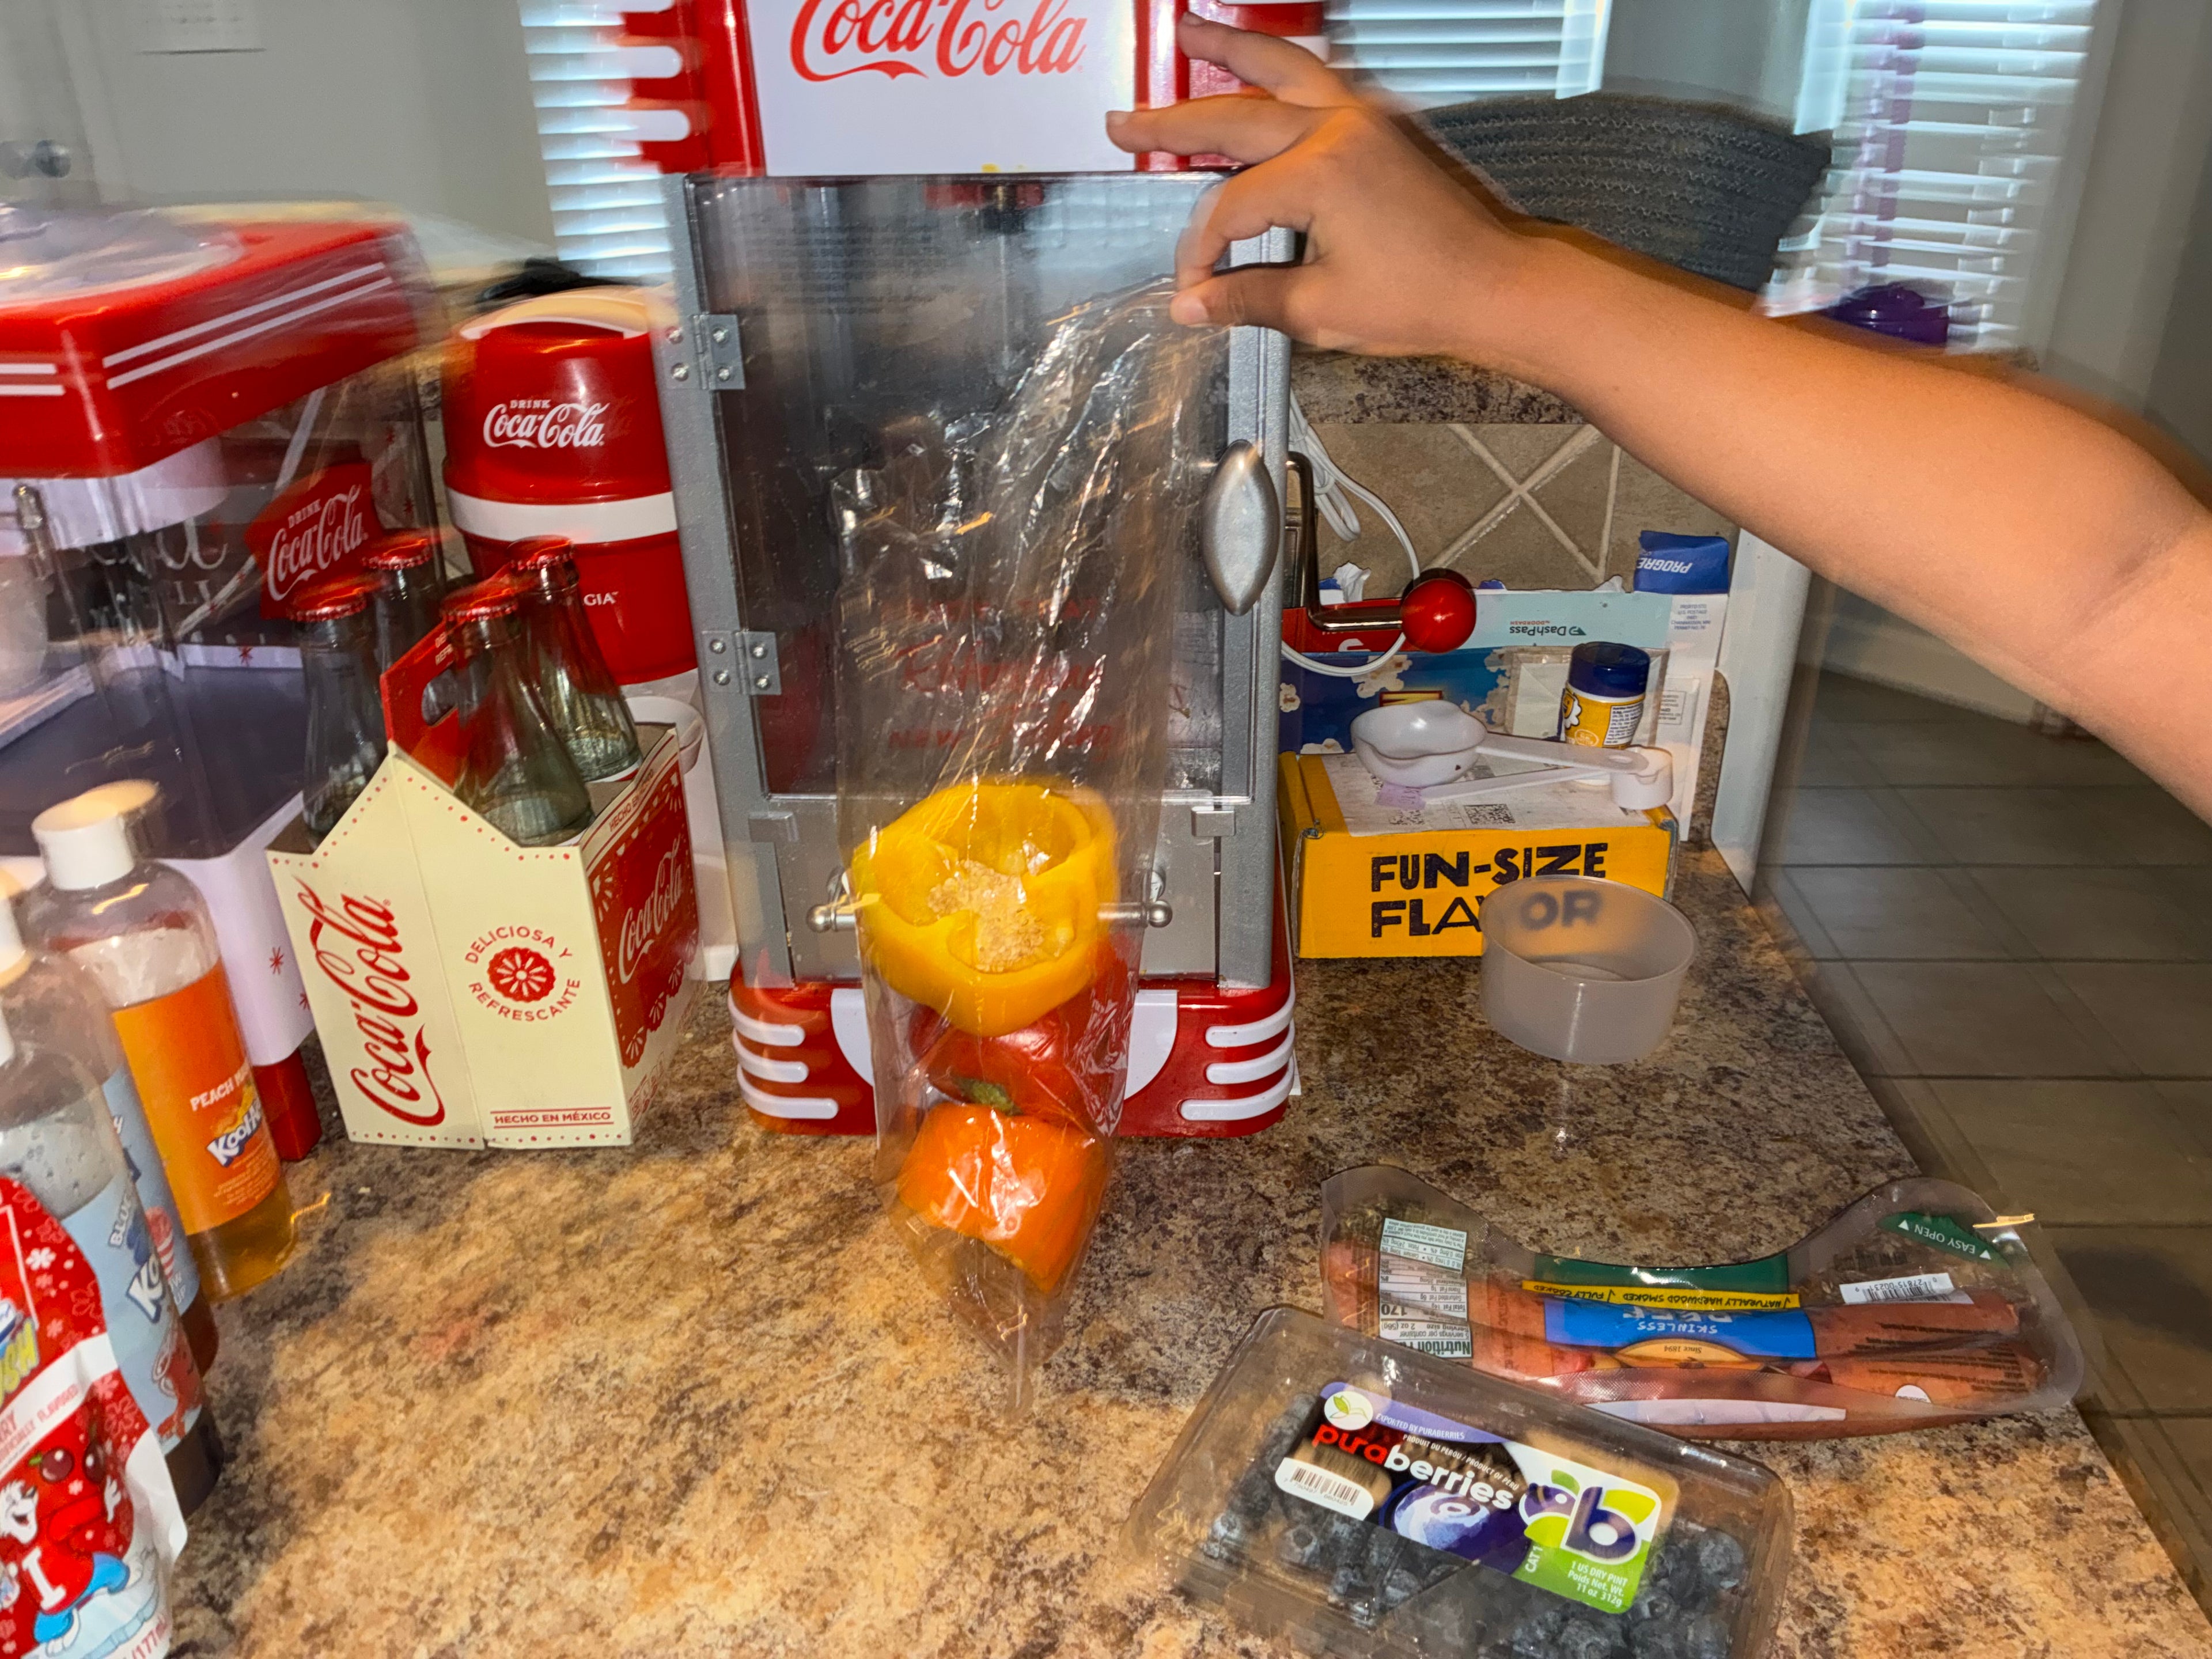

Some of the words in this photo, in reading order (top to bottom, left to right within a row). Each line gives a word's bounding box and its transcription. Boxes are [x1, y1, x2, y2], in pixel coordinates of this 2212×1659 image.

[789, 0, 1088, 82] Coca-Cola
[510, 399, 551, 410] DRINK
[483, 403, 609, 448] Coca-Cola
[288, 499, 321, 529] DRINK
[267, 484, 364, 601] Coca-Cola
[1510, 626, 1567, 636] DashPass
[1371, 843, 1608, 892] FUN-SIZE
[619, 833, 682, 984] Coca-Cola
[1371, 889, 1604, 938] FLAOR
[464, 926, 555, 964] DELICIOSA
[559, 947, 573, 958] Y
[291, 875, 445, 1127] Coca-Cola
[468, 979, 581, 1022] REFRESCANTE
[190, 1077, 235, 1112] PEACH
[495, 1114, 539, 1123] HECHO
[542, 1114, 559, 1122] EN
[562, 1111, 611, 1122] MÉXICO
[1914, 1224, 1945, 1243] OPEN
[1948, 1237, 1975, 1254] EASY
[1574, 1291, 1604, 1300] FULLY
[1623, 1293, 1664, 1303] SMOKED
[1668, 1296, 1722, 1306] HARDWOOD
[1725, 1298, 1782, 1308] NATURALLY
[1381, 1304, 1407, 1316] 170
[1440, 1331, 1464, 1339] servings
[1637, 1321, 1718, 1334] SKINLESS
[1417, 1341, 1471, 1355] Nutrition
[1376, 1413, 1409, 1430] EXPORTED
[1409, 1423, 1418, 1433] BY
[1418, 1426, 1466, 1440] PURABERRIES
[1403, 1434, 1431, 1447] PRODUIT
[1431, 1442, 1441, 1452] DU
[1441, 1446, 1462, 1460] PEROU
[1465, 1456, 1495, 1475] PRODUCT
[1494, 1472, 1503, 1481] OF
[1525, 1551, 1542, 1573] CAT
[1567, 1570, 1590, 1585] Poids
[1592, 1578, 1608, 1592] Net.
[1611, 1584, 1624, 1597] Wt.
[1577, 1563, 1589, 1573] US
[1590, 1567, 1607, 1580] DRY
[1608, 1573, 1628, 1587] PINT
[1577, 1583, 1587, 1593] 11
[1588, 1589, 1598, 1597] oz
[1601, 1592, 1623, 1608] 312g
